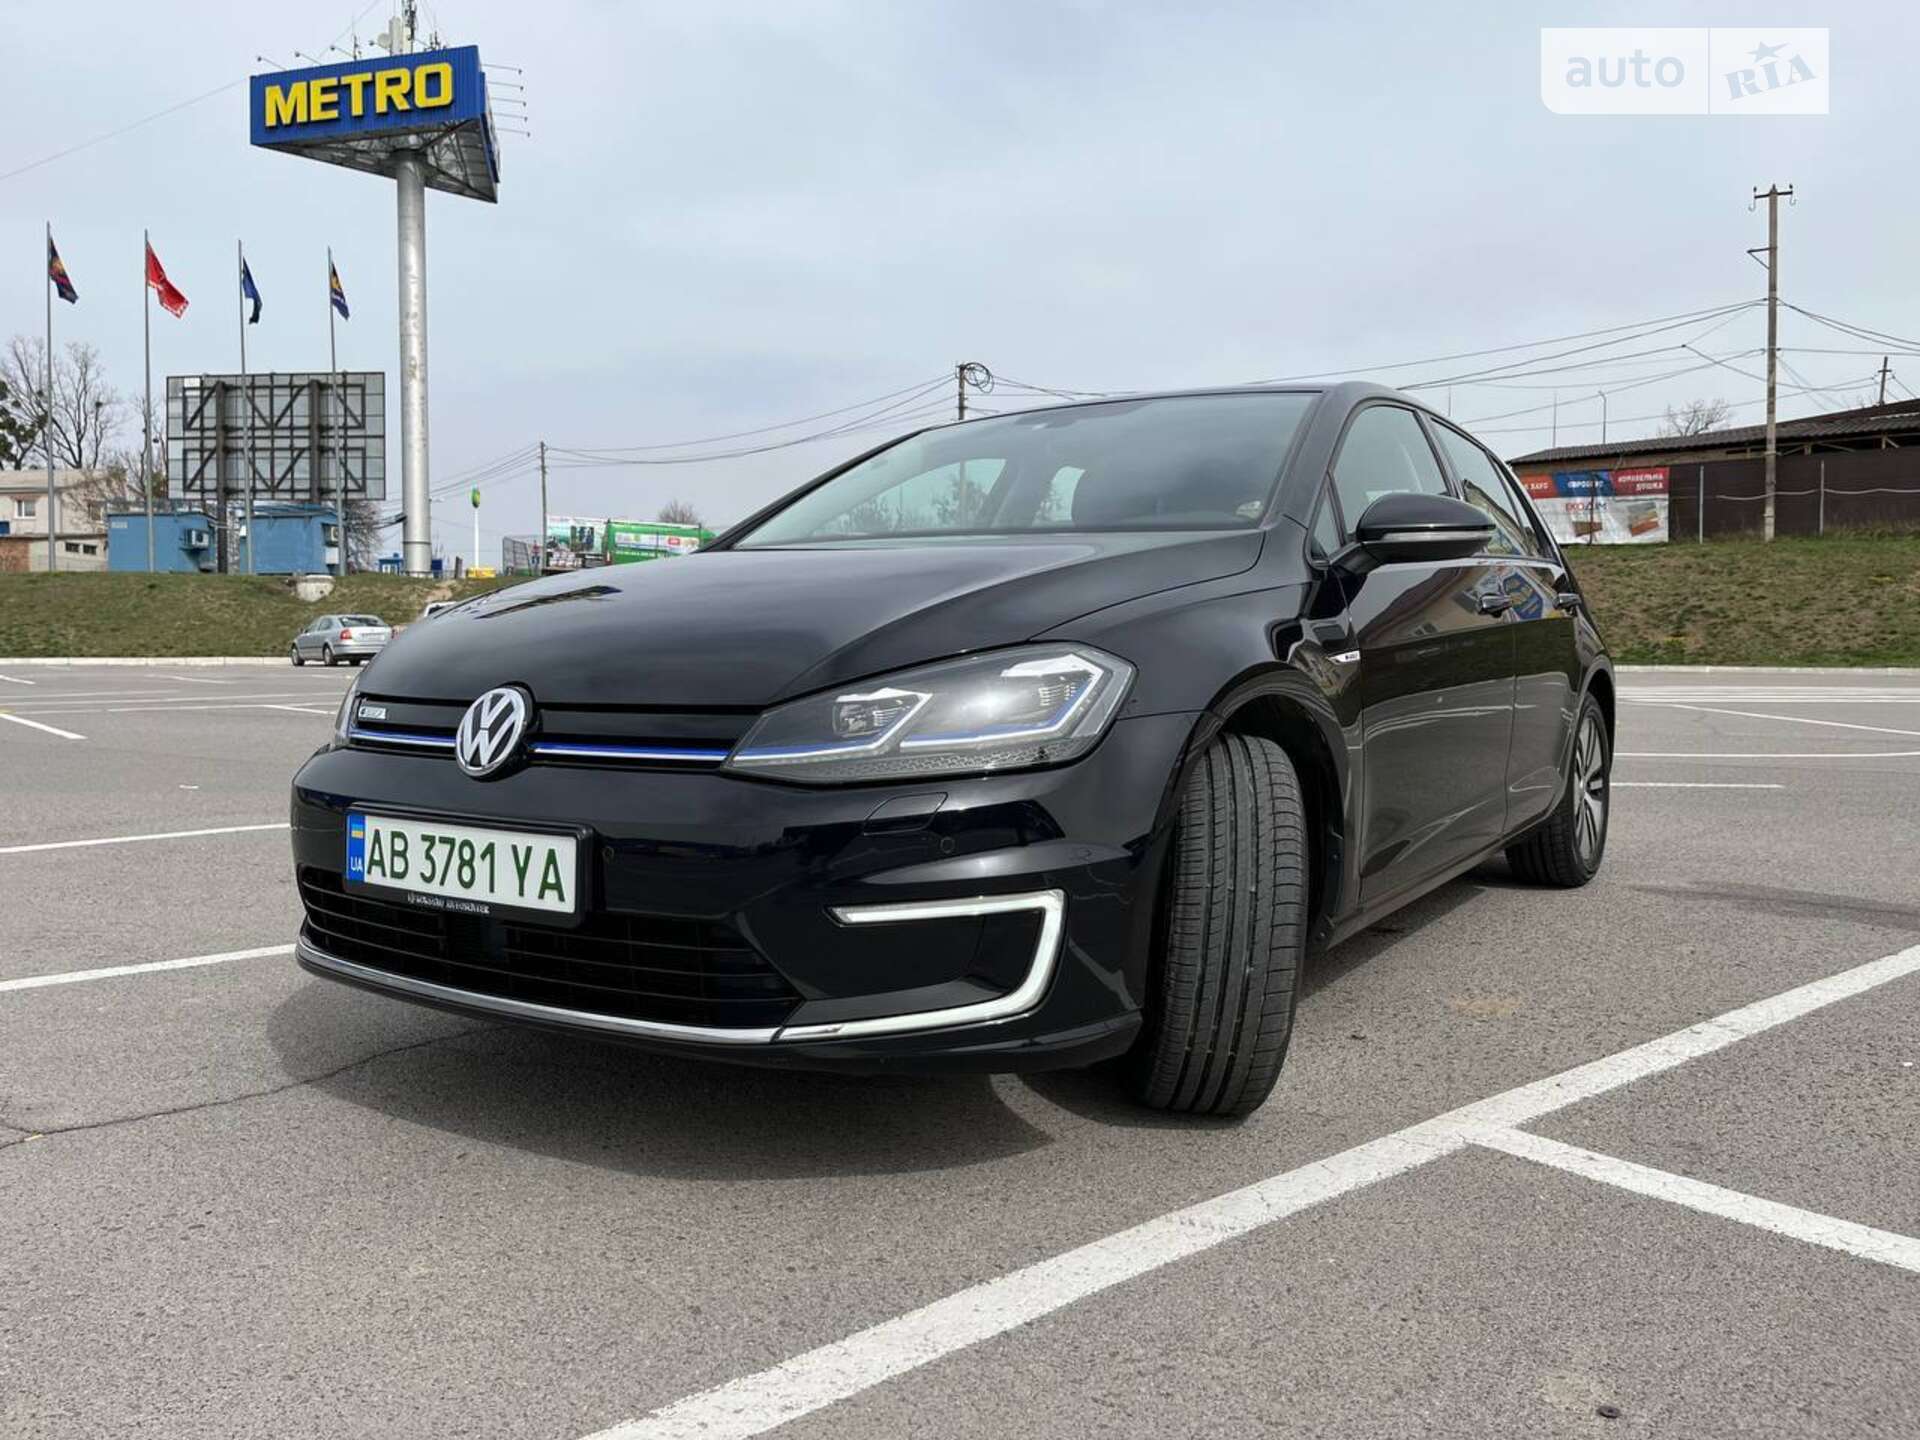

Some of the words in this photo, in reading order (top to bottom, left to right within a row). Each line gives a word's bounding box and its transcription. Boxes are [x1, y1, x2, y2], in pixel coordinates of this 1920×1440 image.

[264, 62, 453, 127] METRO
[350, 856, 364, 873] UA
[366, 828, 410, 880] AB
[419, 833, 496, 894] 3781
[510, 843, 566, 903] YA
